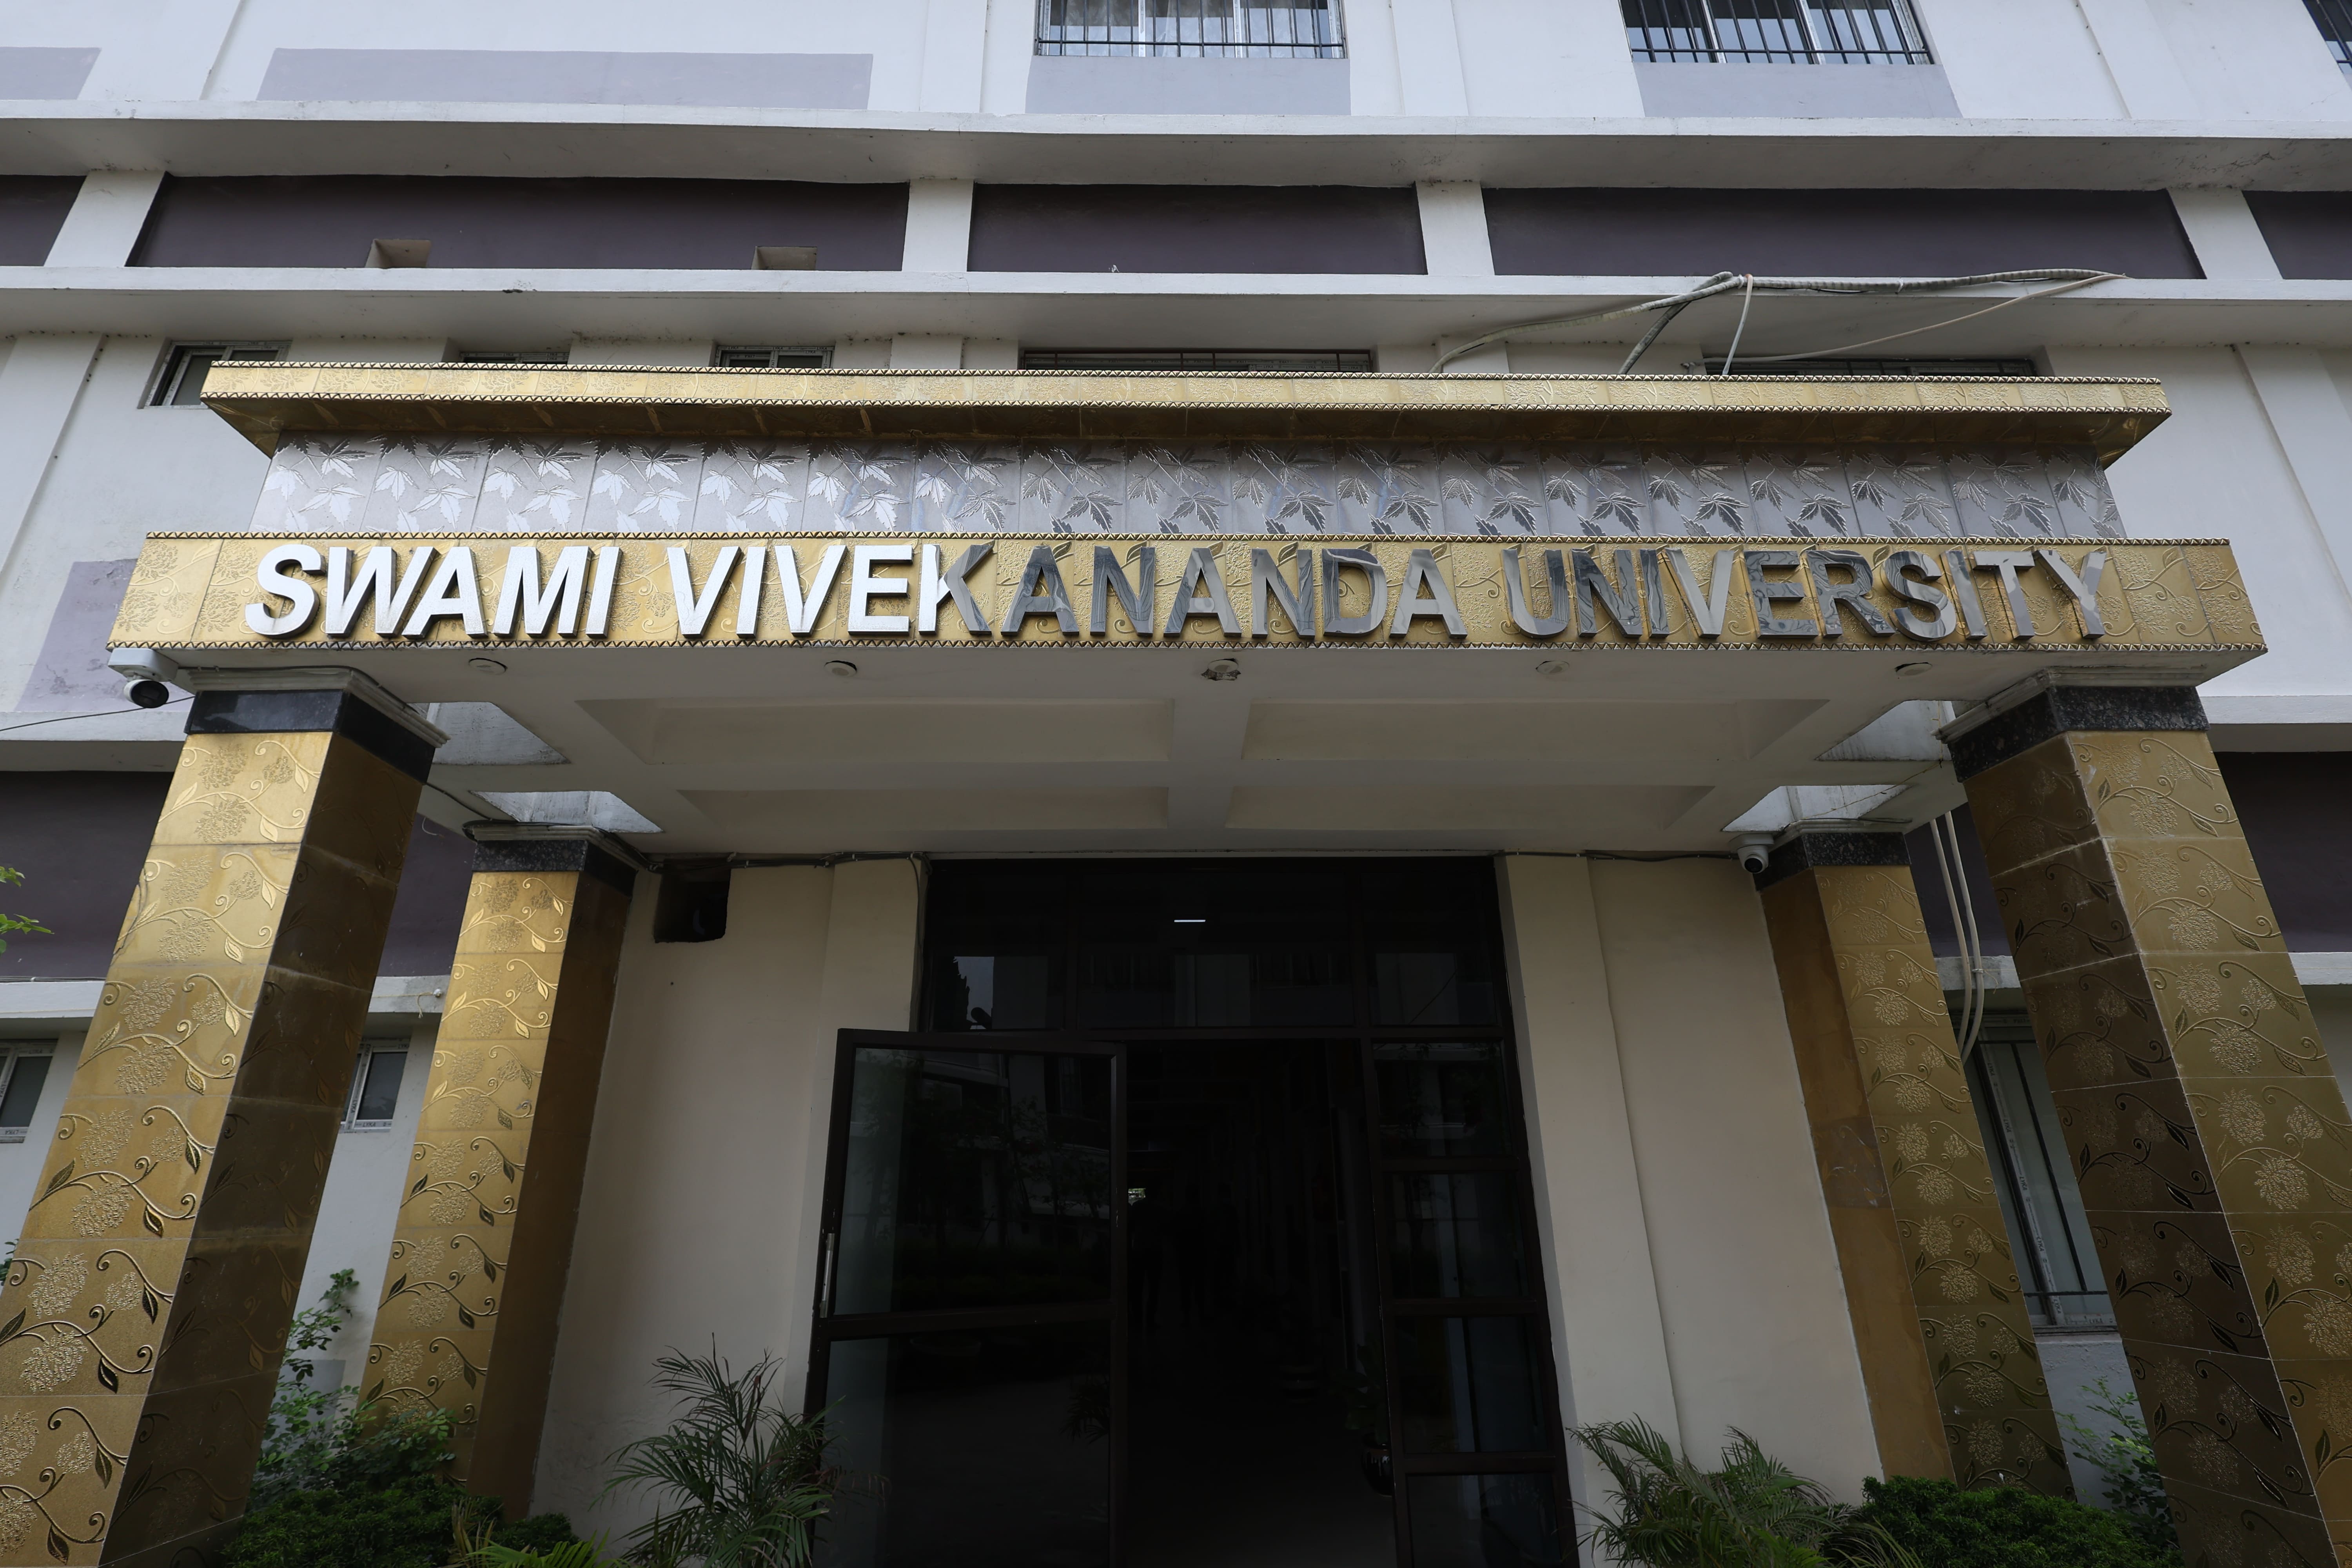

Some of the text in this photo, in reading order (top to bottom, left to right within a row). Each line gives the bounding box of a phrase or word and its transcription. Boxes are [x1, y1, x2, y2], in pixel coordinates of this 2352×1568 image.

[246, 544, 2107, 642] SWAMI VIVEKANANDA UNIVERSITY
[2003, 1119, 2011, 1132] LYKA
[2036, 1236, 2044, 1251] LYKA
